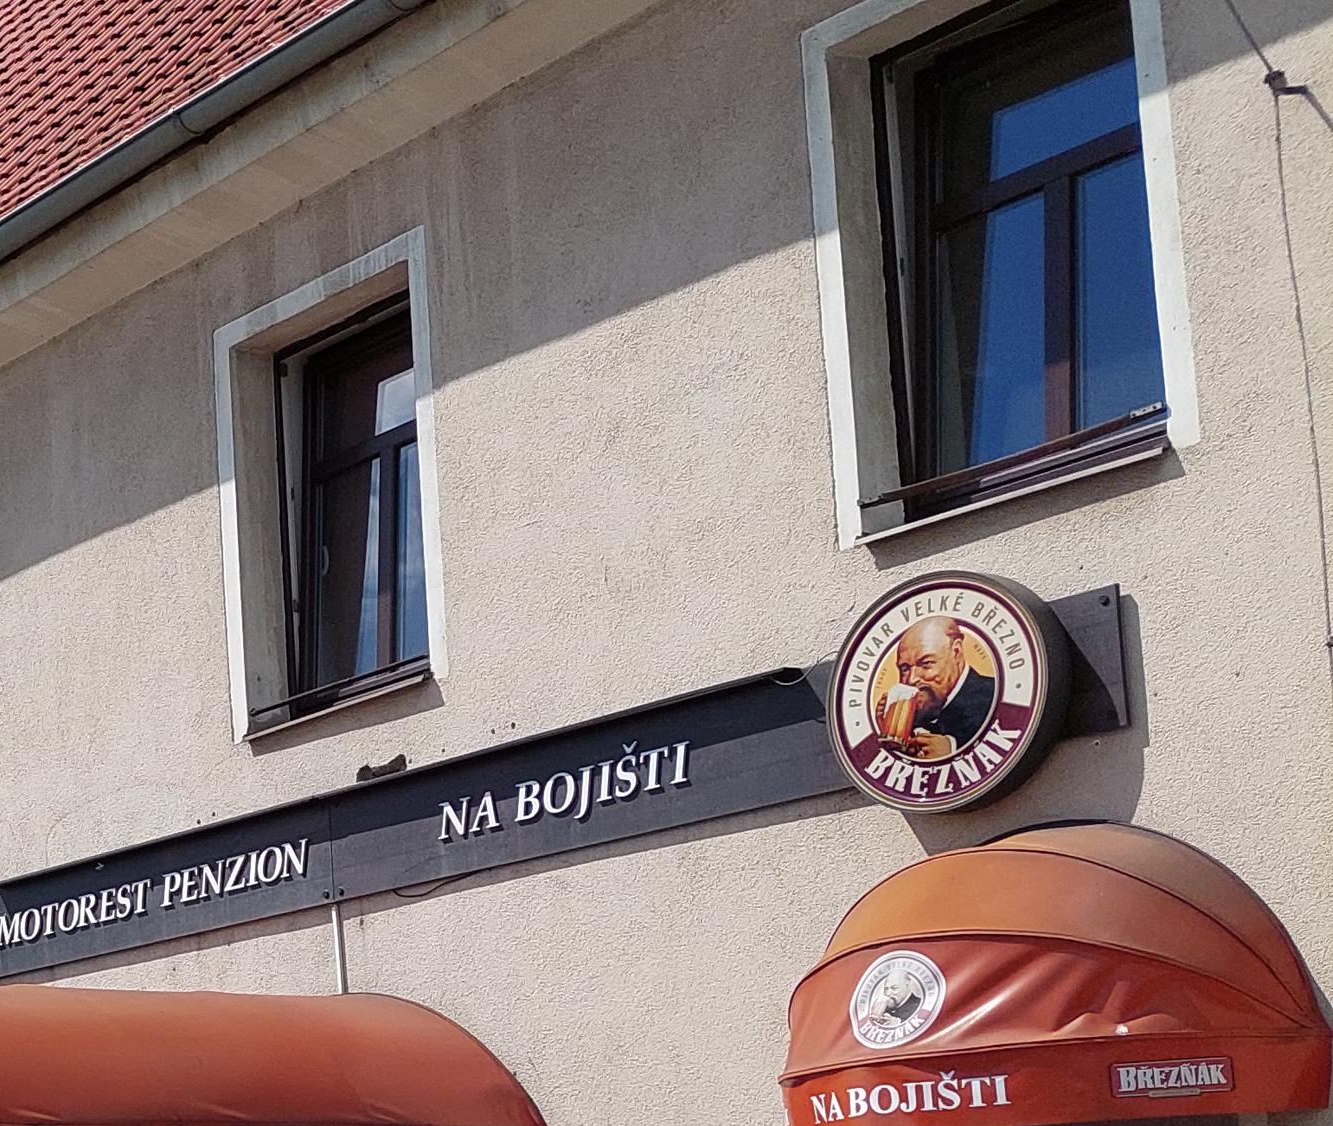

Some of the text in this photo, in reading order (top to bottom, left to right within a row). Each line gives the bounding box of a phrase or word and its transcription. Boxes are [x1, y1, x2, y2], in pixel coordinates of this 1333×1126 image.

[849, 592, 1025, 708] PIVOVAR VELKÉ BŘEZNO
[864, 719, 1022, 797] BŘEZŇÁK
[160, 838, 308, 908] PENZION
[438, 790, 501, 840] NA
[514, 740, 691, 822] BOJIŠTI
[810, 1070, 1012, 1125] NA BOJIŠTI
